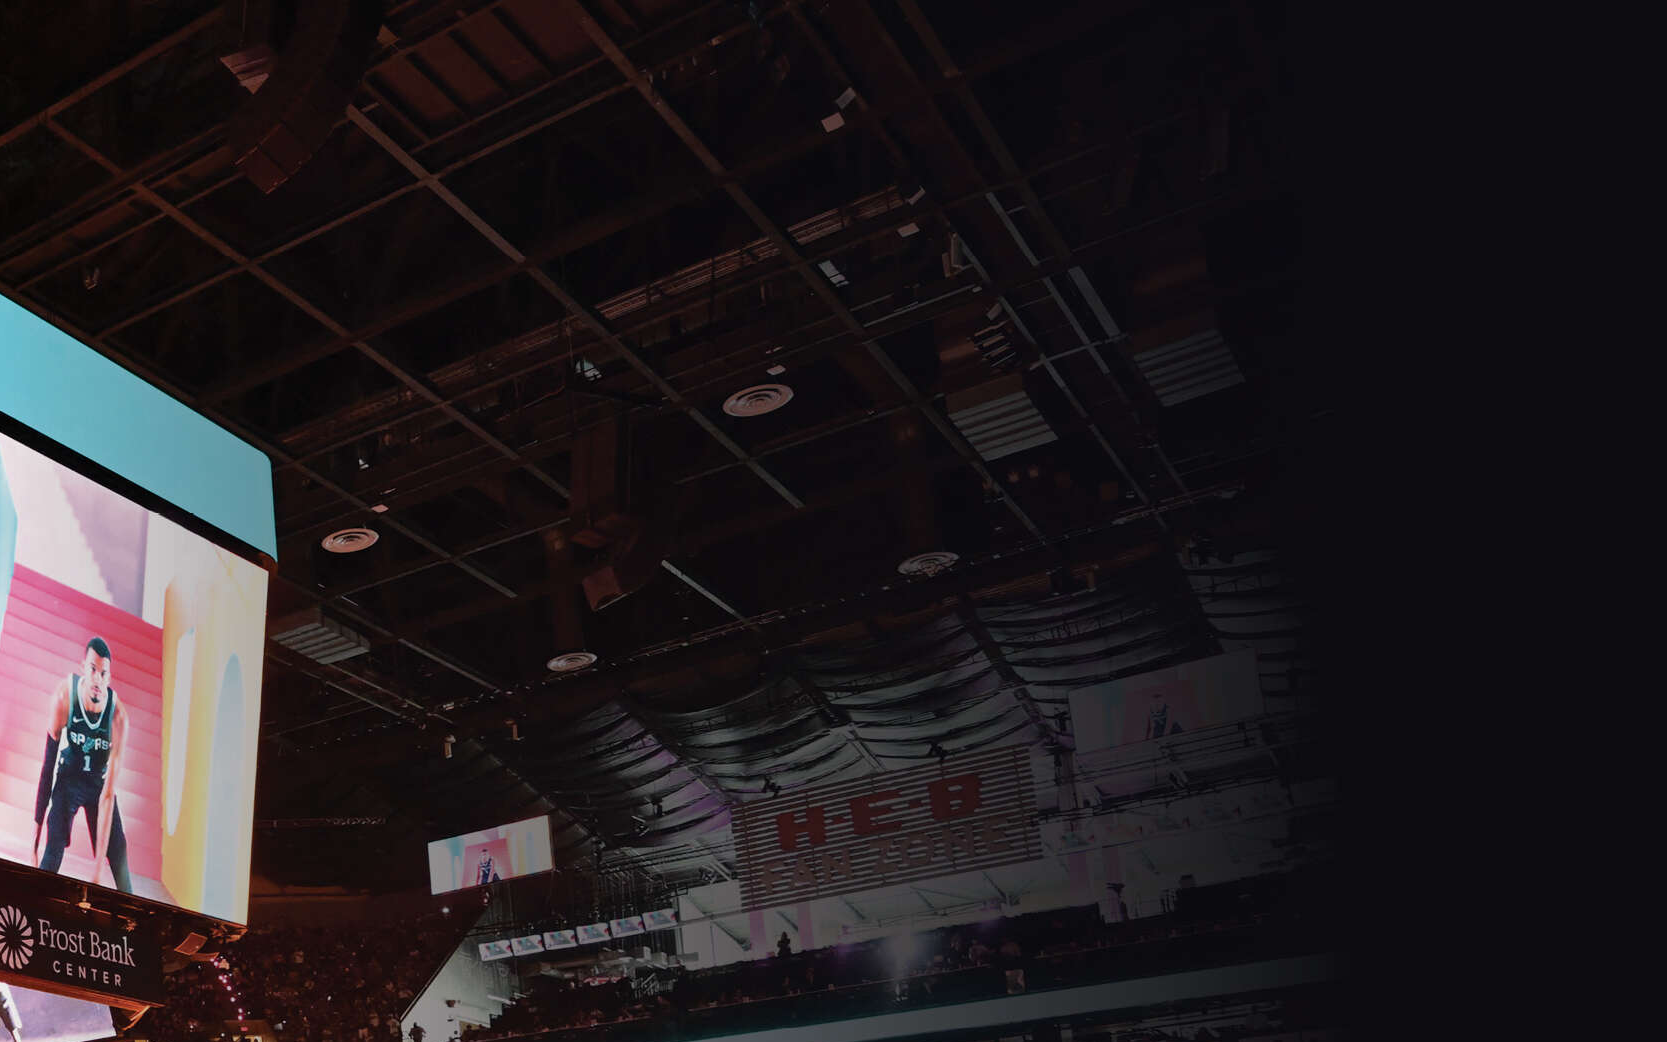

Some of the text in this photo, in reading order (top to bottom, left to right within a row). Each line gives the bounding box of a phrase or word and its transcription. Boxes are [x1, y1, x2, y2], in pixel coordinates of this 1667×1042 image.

[83, 754, 92, 771] 1
[758, 816, 1015, 895] FAN ZONE
[37, 918, 136, 967] Frost Bank
[52, 960, 122, 987] CENTER
